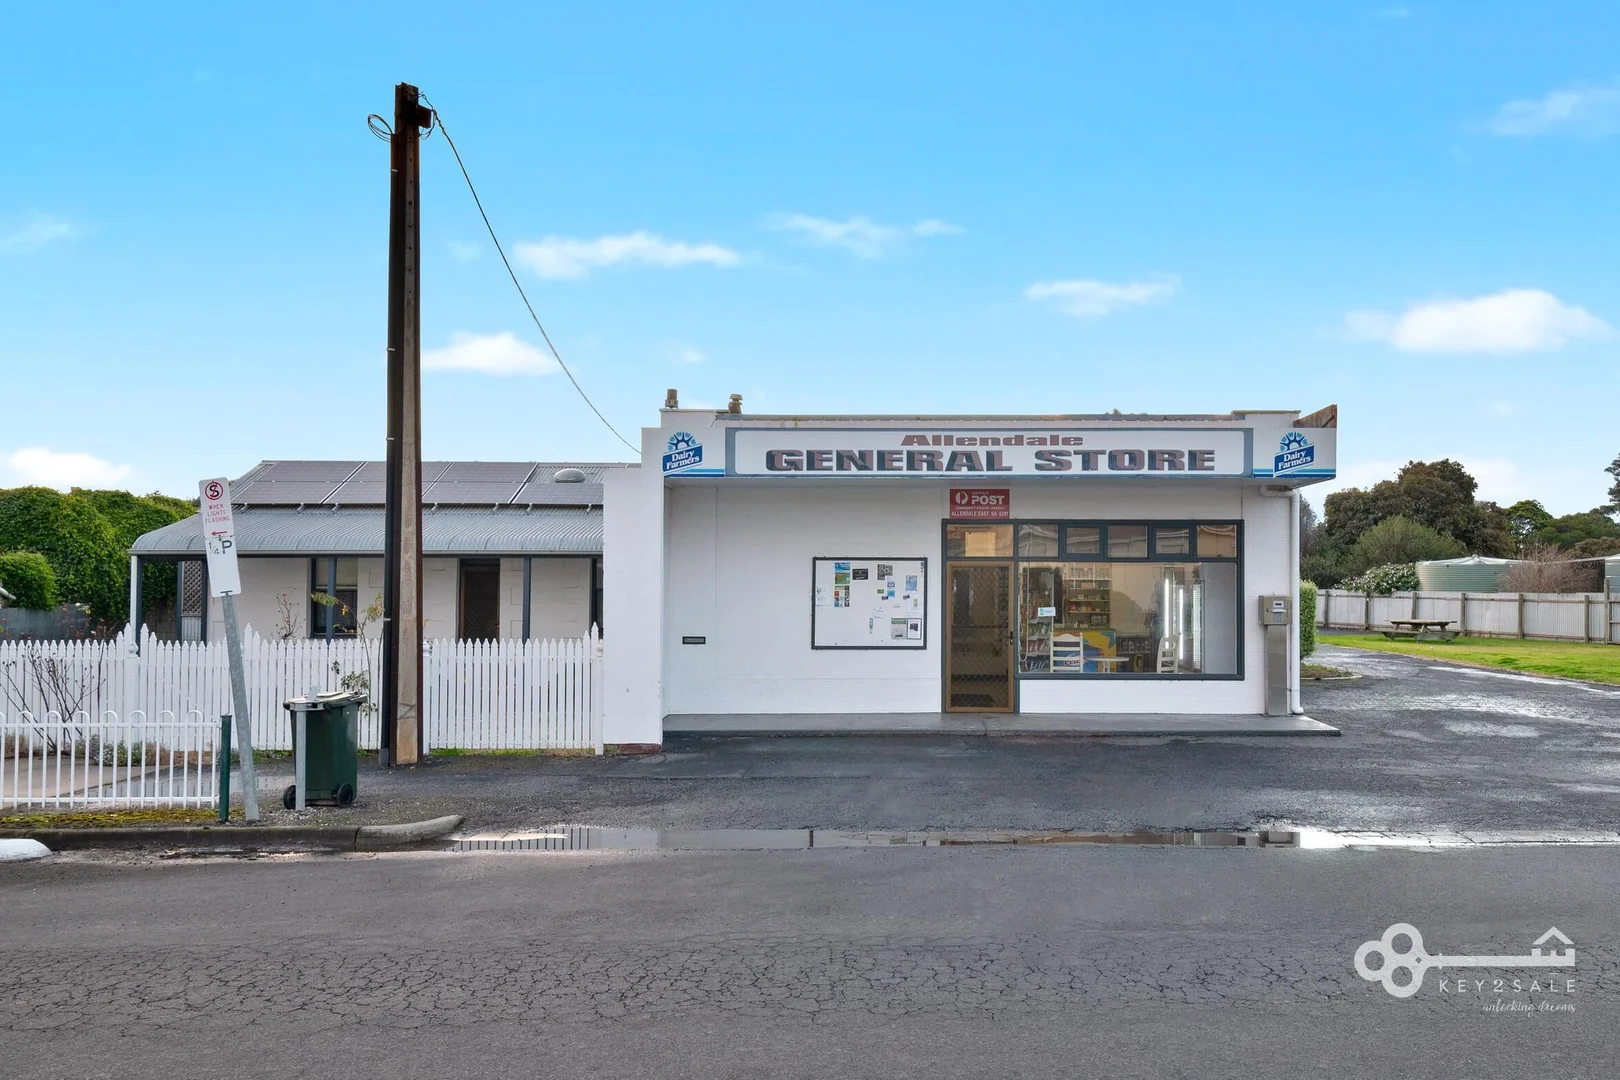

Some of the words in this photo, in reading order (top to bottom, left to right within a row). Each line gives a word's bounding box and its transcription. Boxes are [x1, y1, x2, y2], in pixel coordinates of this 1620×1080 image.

[900, 434, 1083, 447] Allendale
[671, 450, 695, 462] Dairy
[765, 449, 1013, 472] GENERAL
[1034, 449, 1216, 472] STORE
[1283, 450, 1307, 462] Dairy
[666, 456, 700, 470] Farmers
[1278, 455, 1312, 470] Farmers
[971, 495, 1005, 505] POST
[207, 509, 227, 517] LIGHTS
[204, 515, 231, 524] FLASHING
